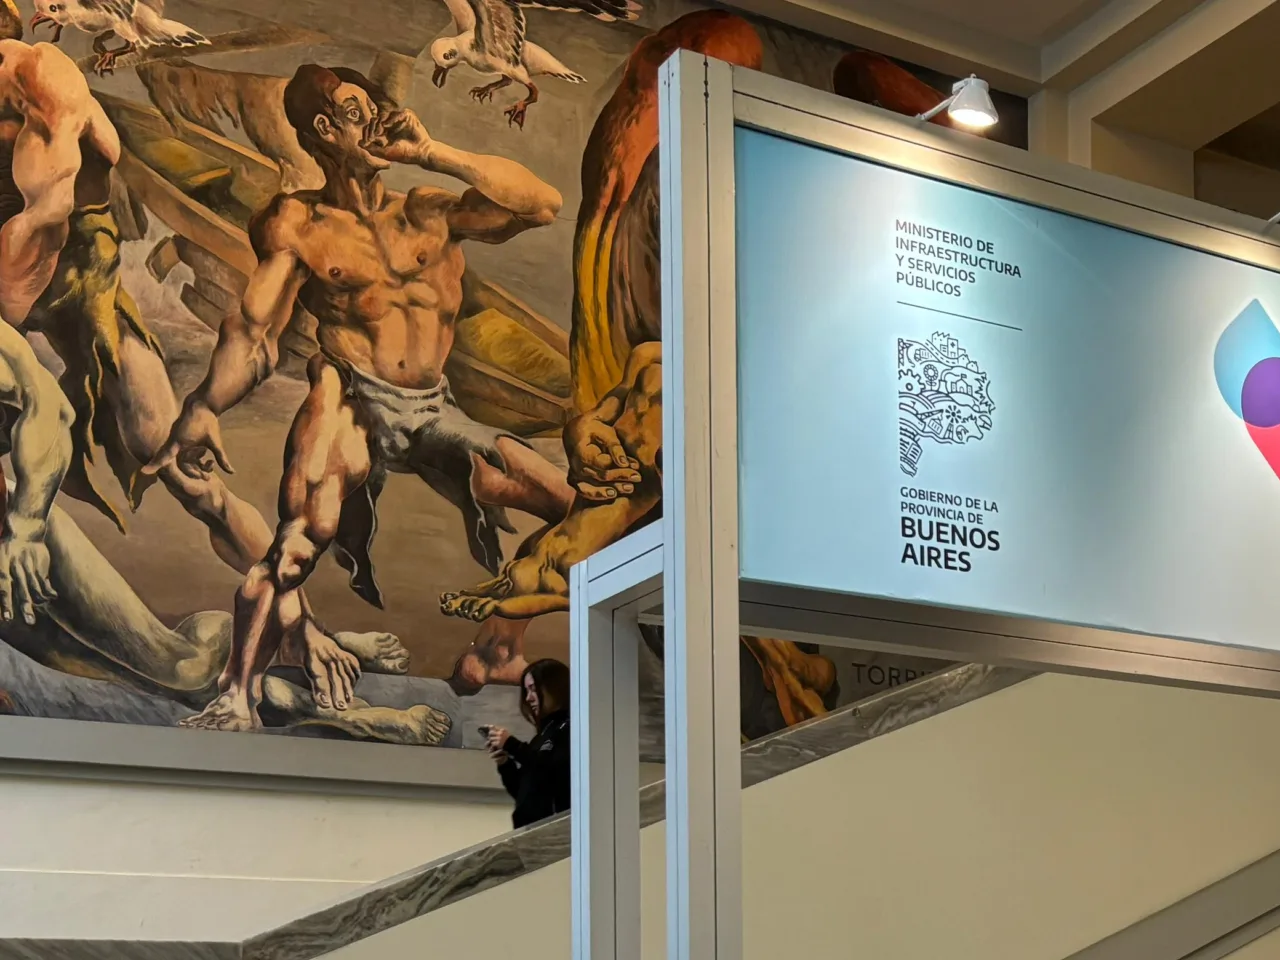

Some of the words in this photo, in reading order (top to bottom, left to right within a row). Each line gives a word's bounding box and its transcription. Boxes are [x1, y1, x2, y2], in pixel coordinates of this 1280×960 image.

[896, 219, 973, 249] MINISTERIO
[976, 239, 995, 255] DE
[895, 236, 1022, 278] INFRAESTRUCTURA
[895, 253, 905, 267] Y
[907, 257, 976, 284] SERVICIOS
[896, 271, 962, 297] PÚBLICOS
[900, 486, 962, 506] GOBIERNO
[965, 497, 981, 510] DE
[984, 500, 999, 513] LA
[900, 501, 965, 522] PROVINCIA
[968, 512, 984, 525] DE
[900, 516, 1001, 551] BUENOS
[900, 543, 972, 573] AIRES
